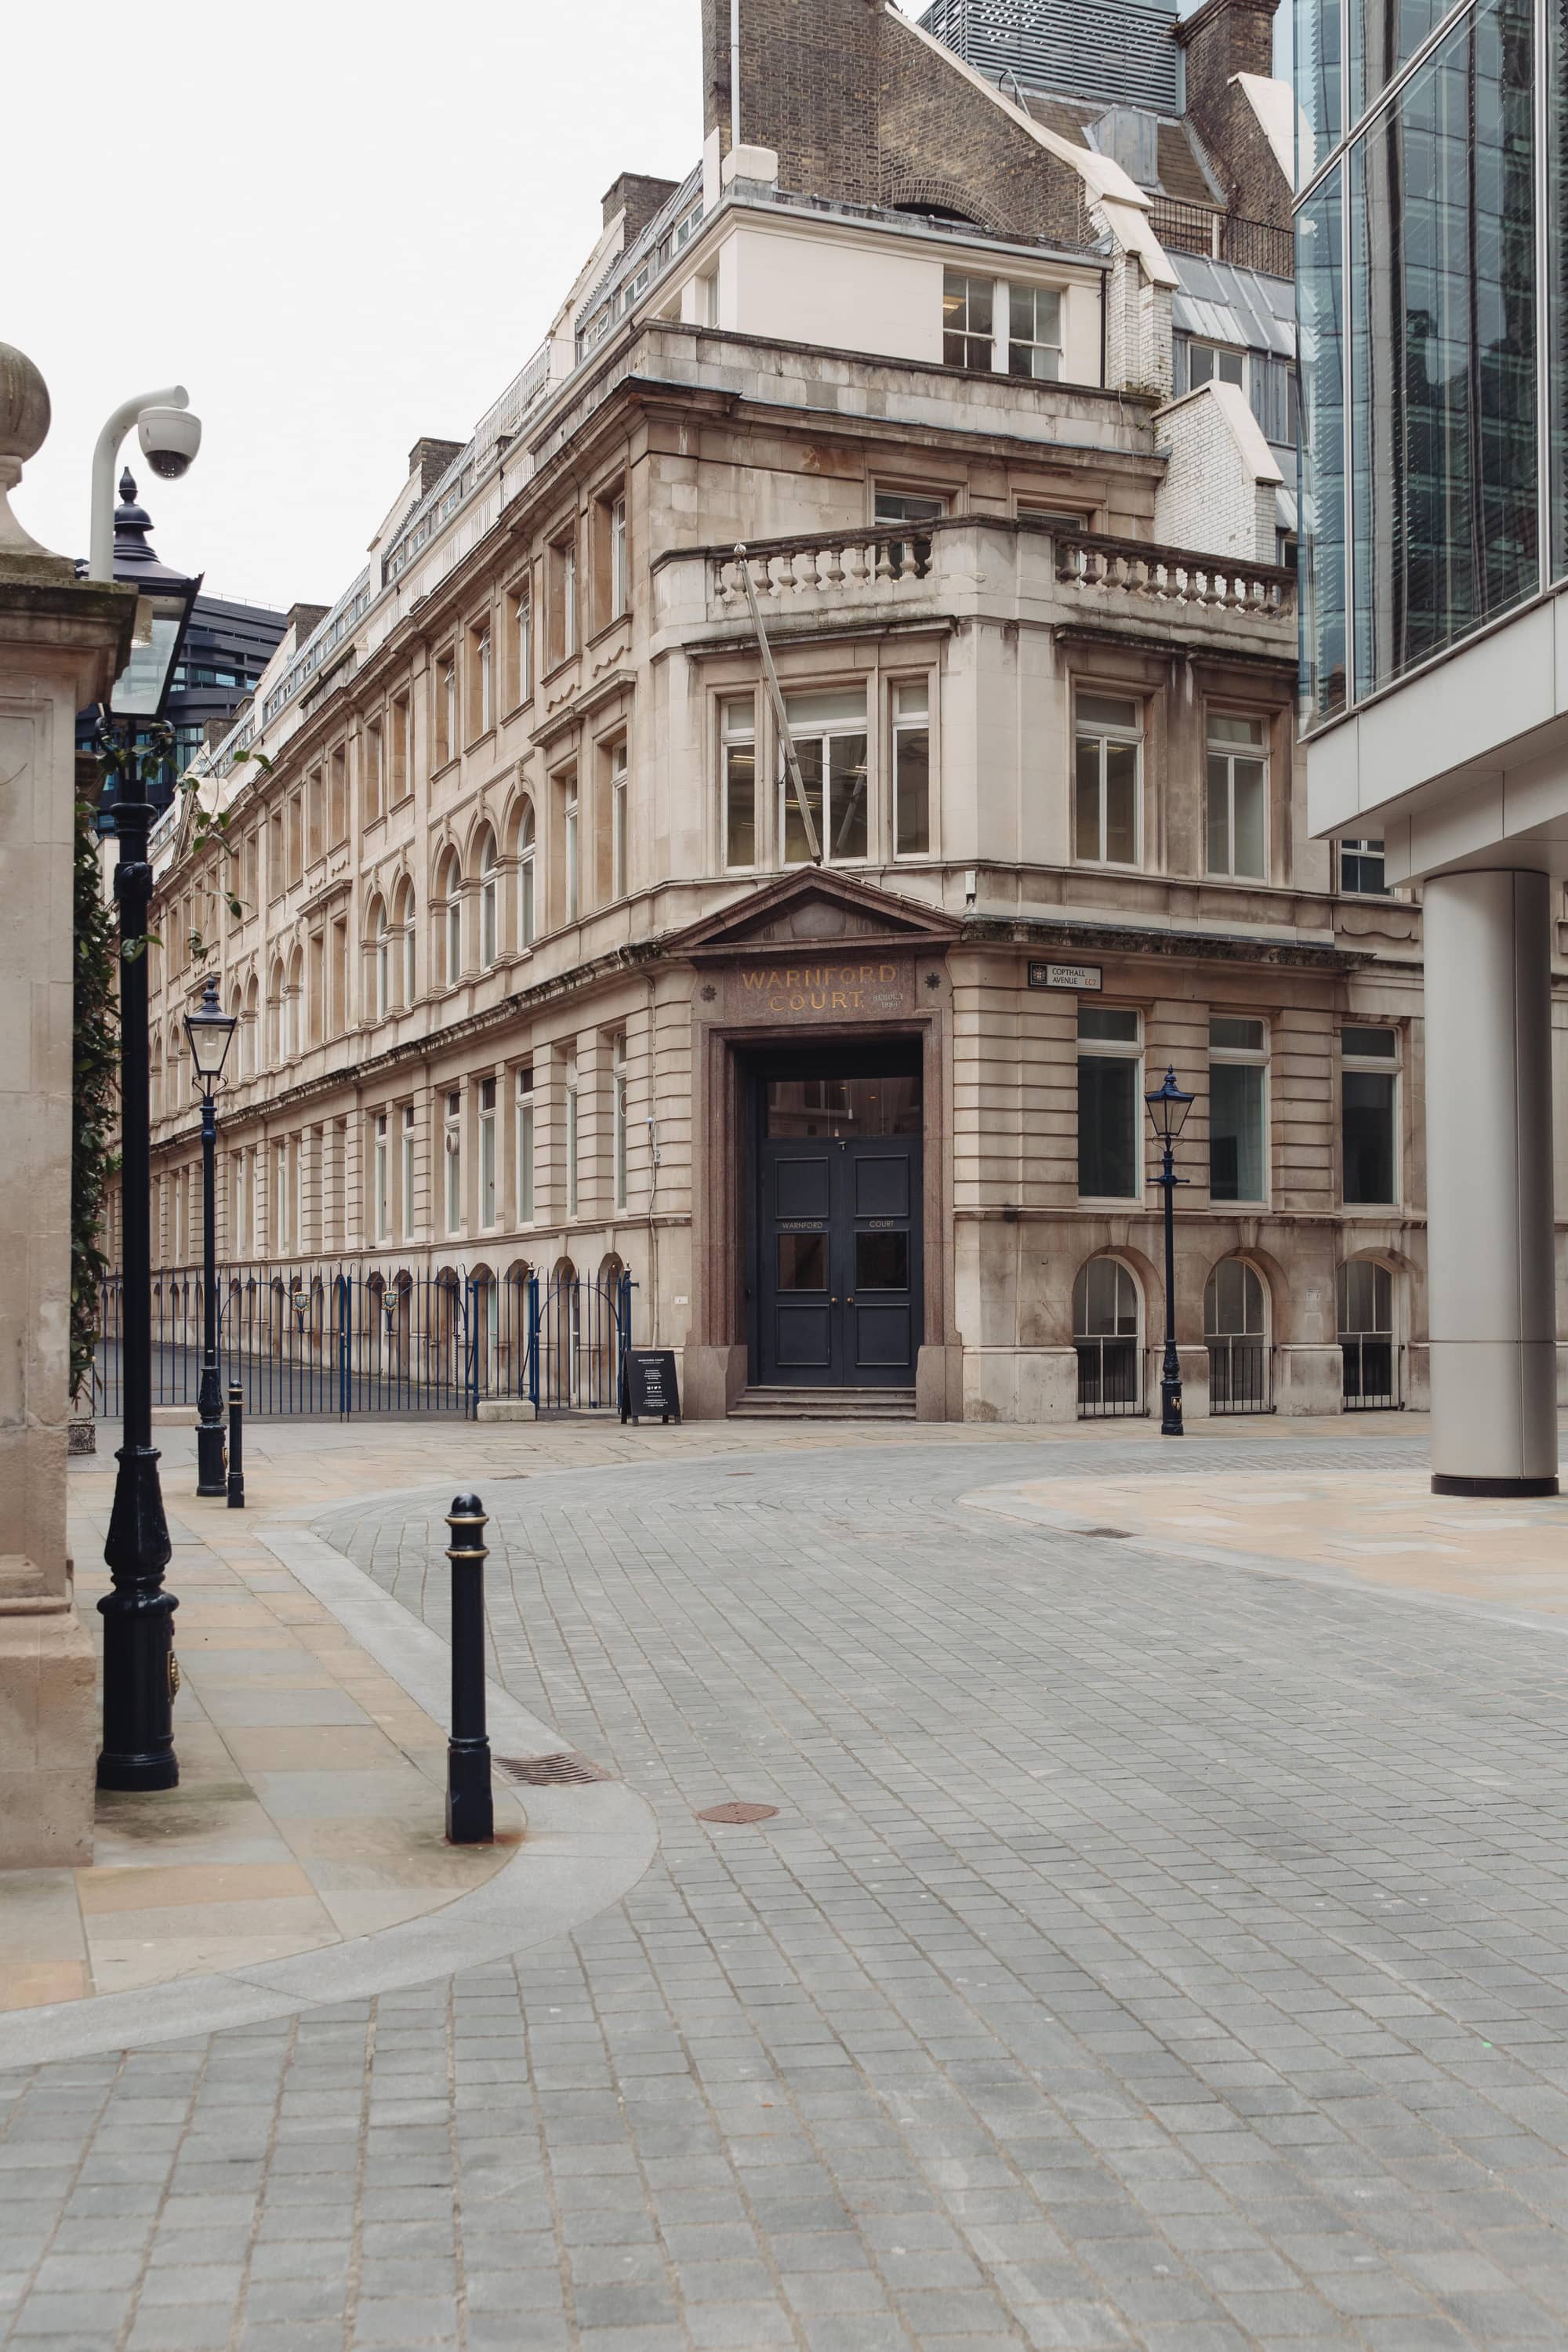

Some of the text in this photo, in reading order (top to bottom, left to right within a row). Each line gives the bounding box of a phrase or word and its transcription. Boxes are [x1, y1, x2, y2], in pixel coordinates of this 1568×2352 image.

[742, 964, 897, 990] WARNFORD
[1052, 967, 1085, 977] COPTHALL
[1052, 976, 1078, 985] AVENUE
